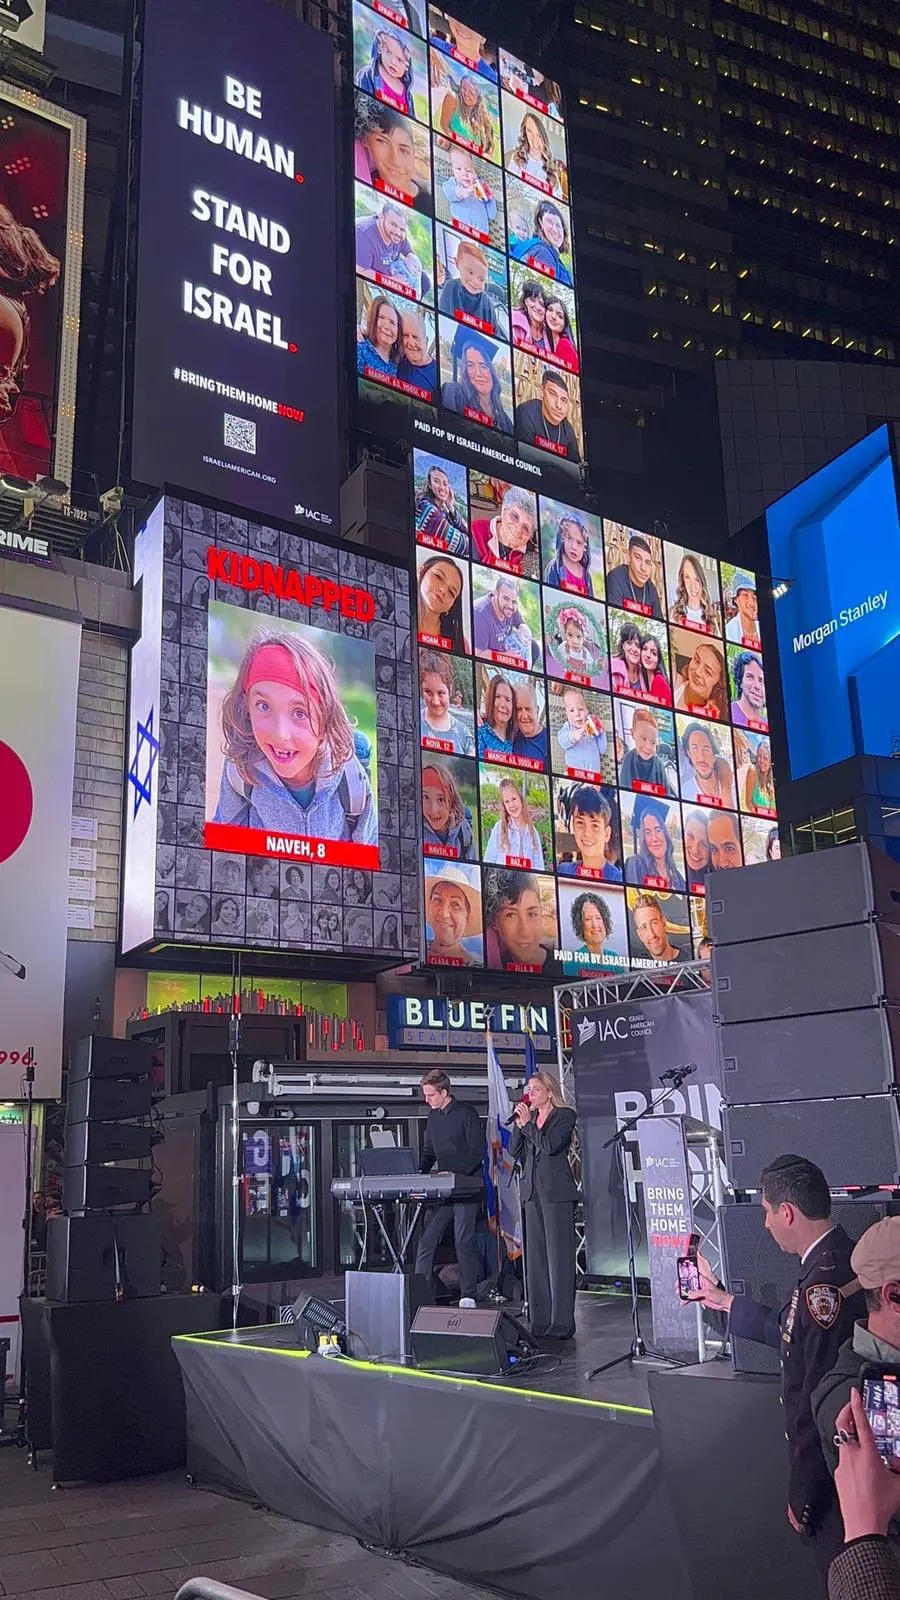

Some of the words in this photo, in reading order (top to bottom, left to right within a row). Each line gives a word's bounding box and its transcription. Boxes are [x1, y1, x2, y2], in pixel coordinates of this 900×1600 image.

[226, 75, 262, 119] BE
[178, 98, 304, 183] HUMAN.
[191, 188, 291, 254] STAND
[212, 243, 272, 296] FOR
[183, 280, 298, 353] ISRAEL.
[414, 419, 431, 433] PAID
[446, 431, 456, 443] BY
[456, 435, 481, 453] ISRAELI
[481, 446, 515, 465] AMERICAN
[515, 459, 542, 477] COUNCIL
[203, 455, 277, 484] ISRAELIAMERICAN.ORG
[305, 508, 320, 521] IAC
[207, 544, 376, 623] KIDNAPPED
[793, 619, 838, 653] Morgan
[840, 590, 888, 627] Stanley
[422, 635, 440, 646] NOAM,
[497, 655, 517, 666] YARDEN,
[426, 738, 442, 748] NOYA,
[266, 836, 314, 859] NAVEH,
[317, 843, 326, 858] 8
[428, 844, 448, 856] NAVEH,
[554, 949, 573, 961] PAID
[574, 952, 590, 963] FOR
[591, 953, 600, 964] BY
[602, 954, 630, 967] ISRAELI
[405, 998, 486, 1029] BLUE
[502, 1004, 548, 1033] FIN
[630, 1020, 655, 1029] AMERICAN
[598, 1017, 628, 1041] IAC
[655, 1157, 669, 1168] IAC
[647, 1187, 684, 1200] BRING
[650, 1203, 684, 1216] THEM
[651, 1218, 687, 1232] HOME
